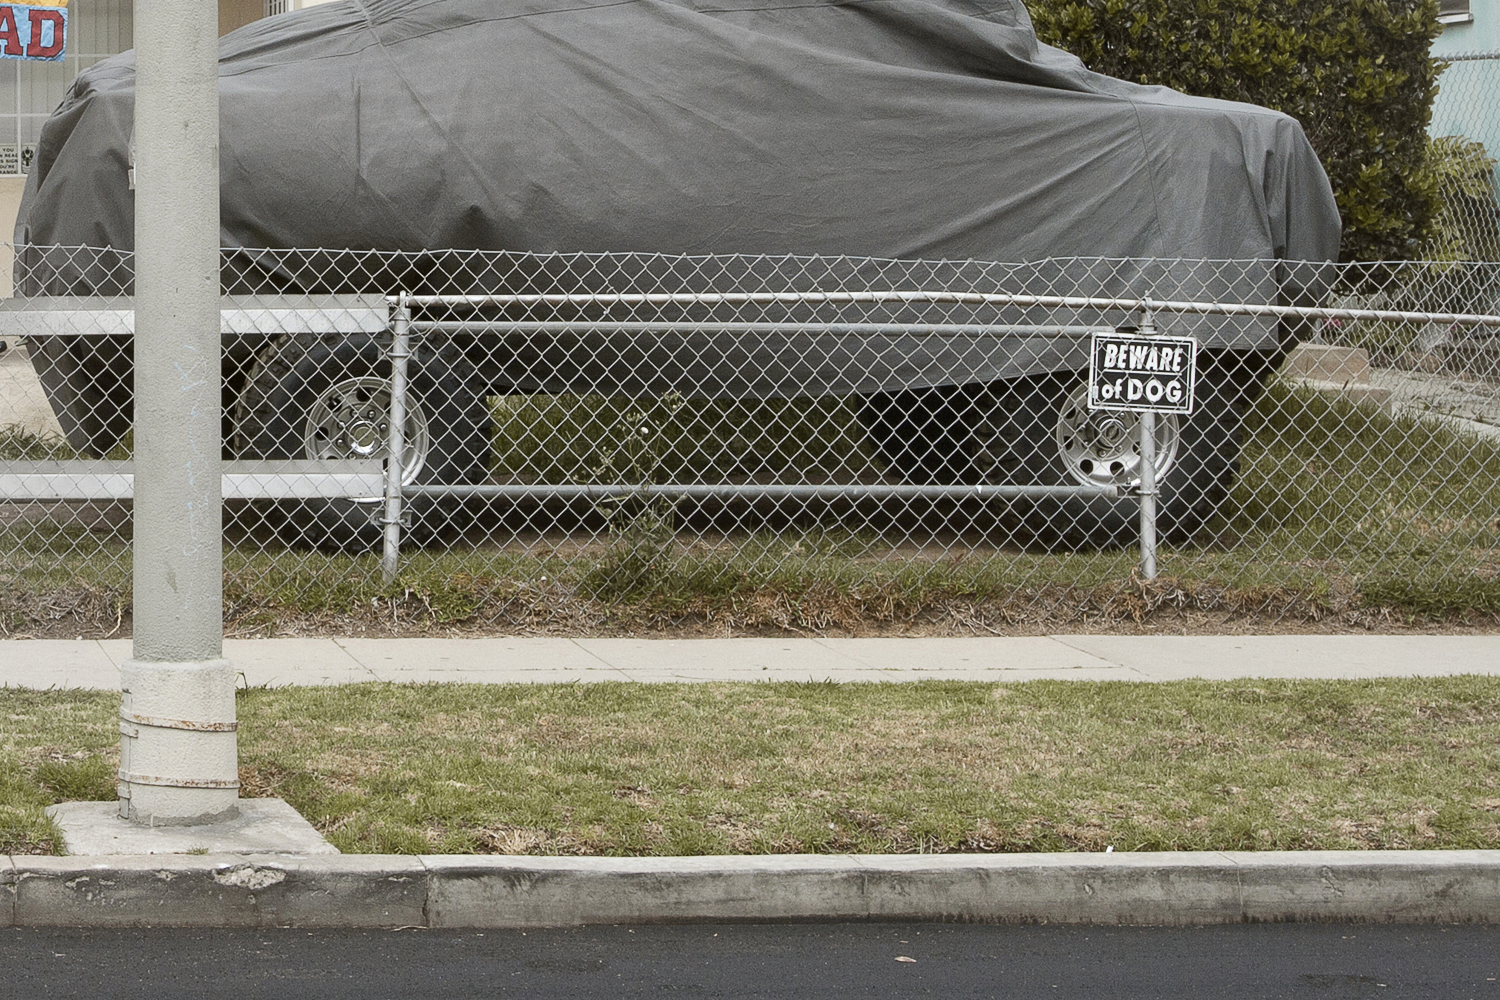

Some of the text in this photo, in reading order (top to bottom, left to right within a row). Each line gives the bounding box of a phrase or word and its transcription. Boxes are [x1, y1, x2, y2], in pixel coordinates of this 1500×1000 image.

[1104, 344, 1184, 372] BEWARE
[1101, 379, 1182, 403] of DOG
